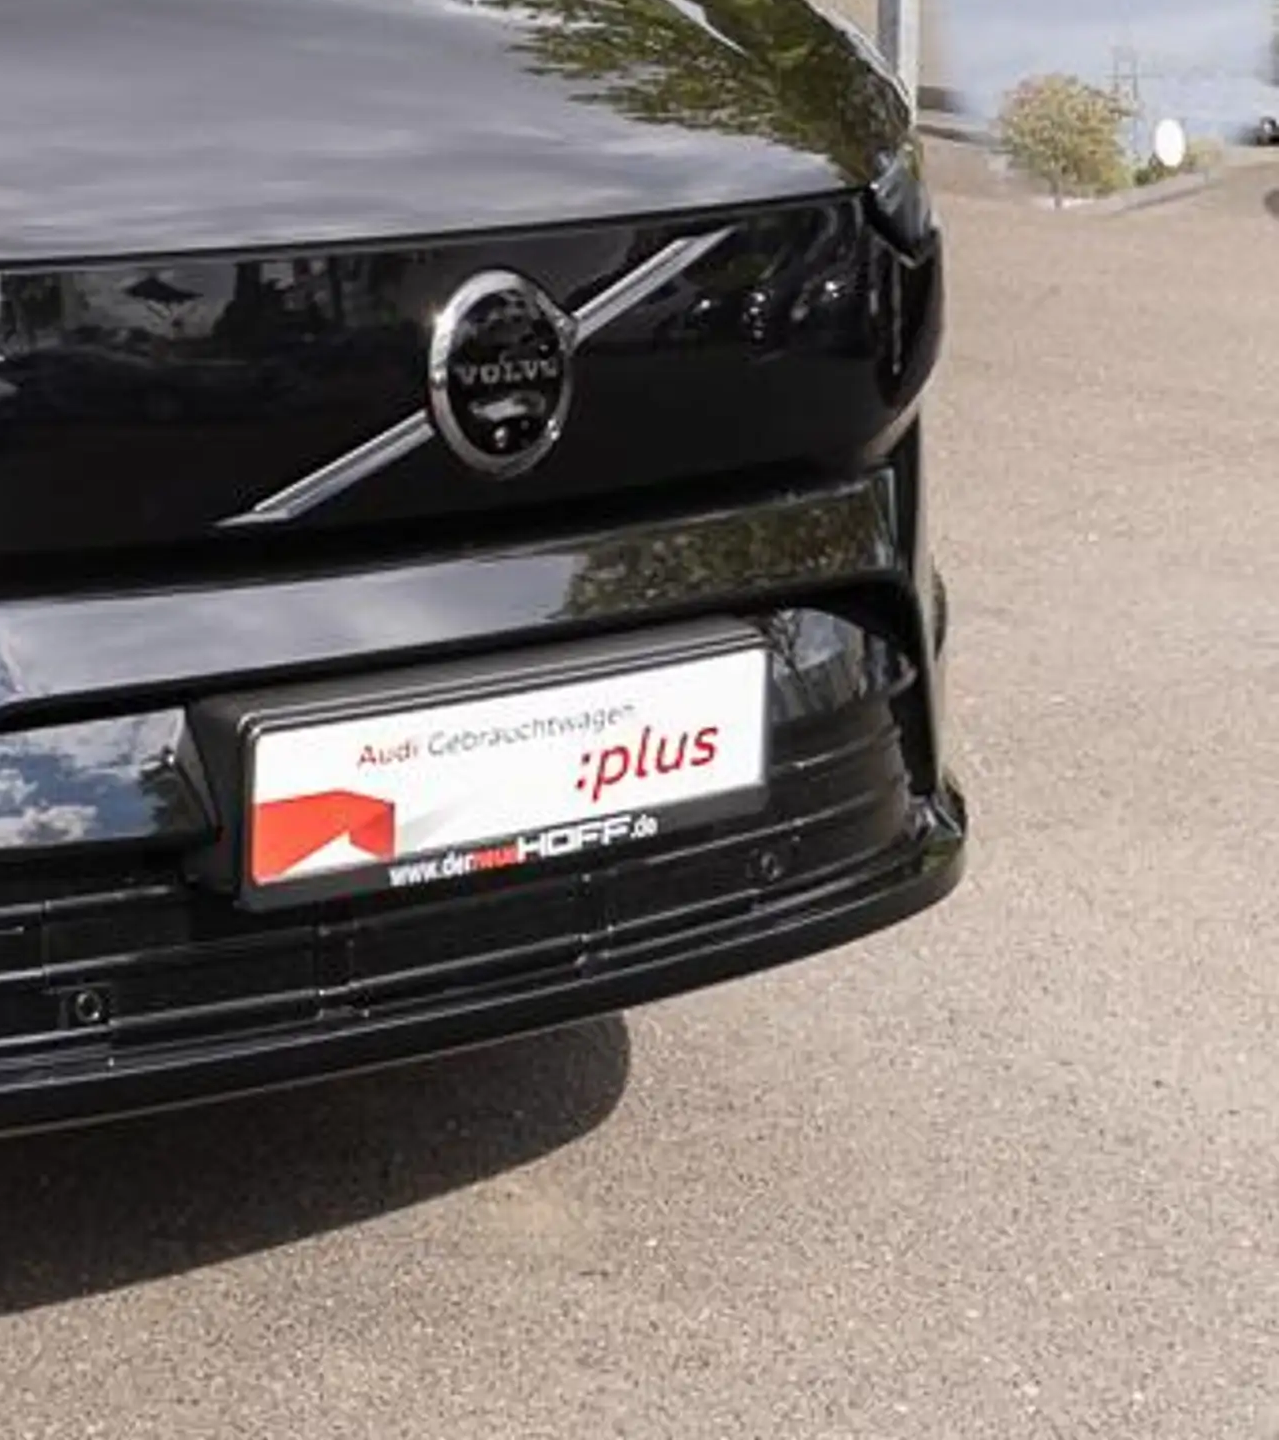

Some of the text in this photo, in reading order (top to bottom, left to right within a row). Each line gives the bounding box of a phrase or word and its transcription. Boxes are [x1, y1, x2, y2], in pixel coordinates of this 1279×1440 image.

[454, 357, 558, 385] VOLVO
[357, 704, 635, 769] Audi Gebrauchtwagen
